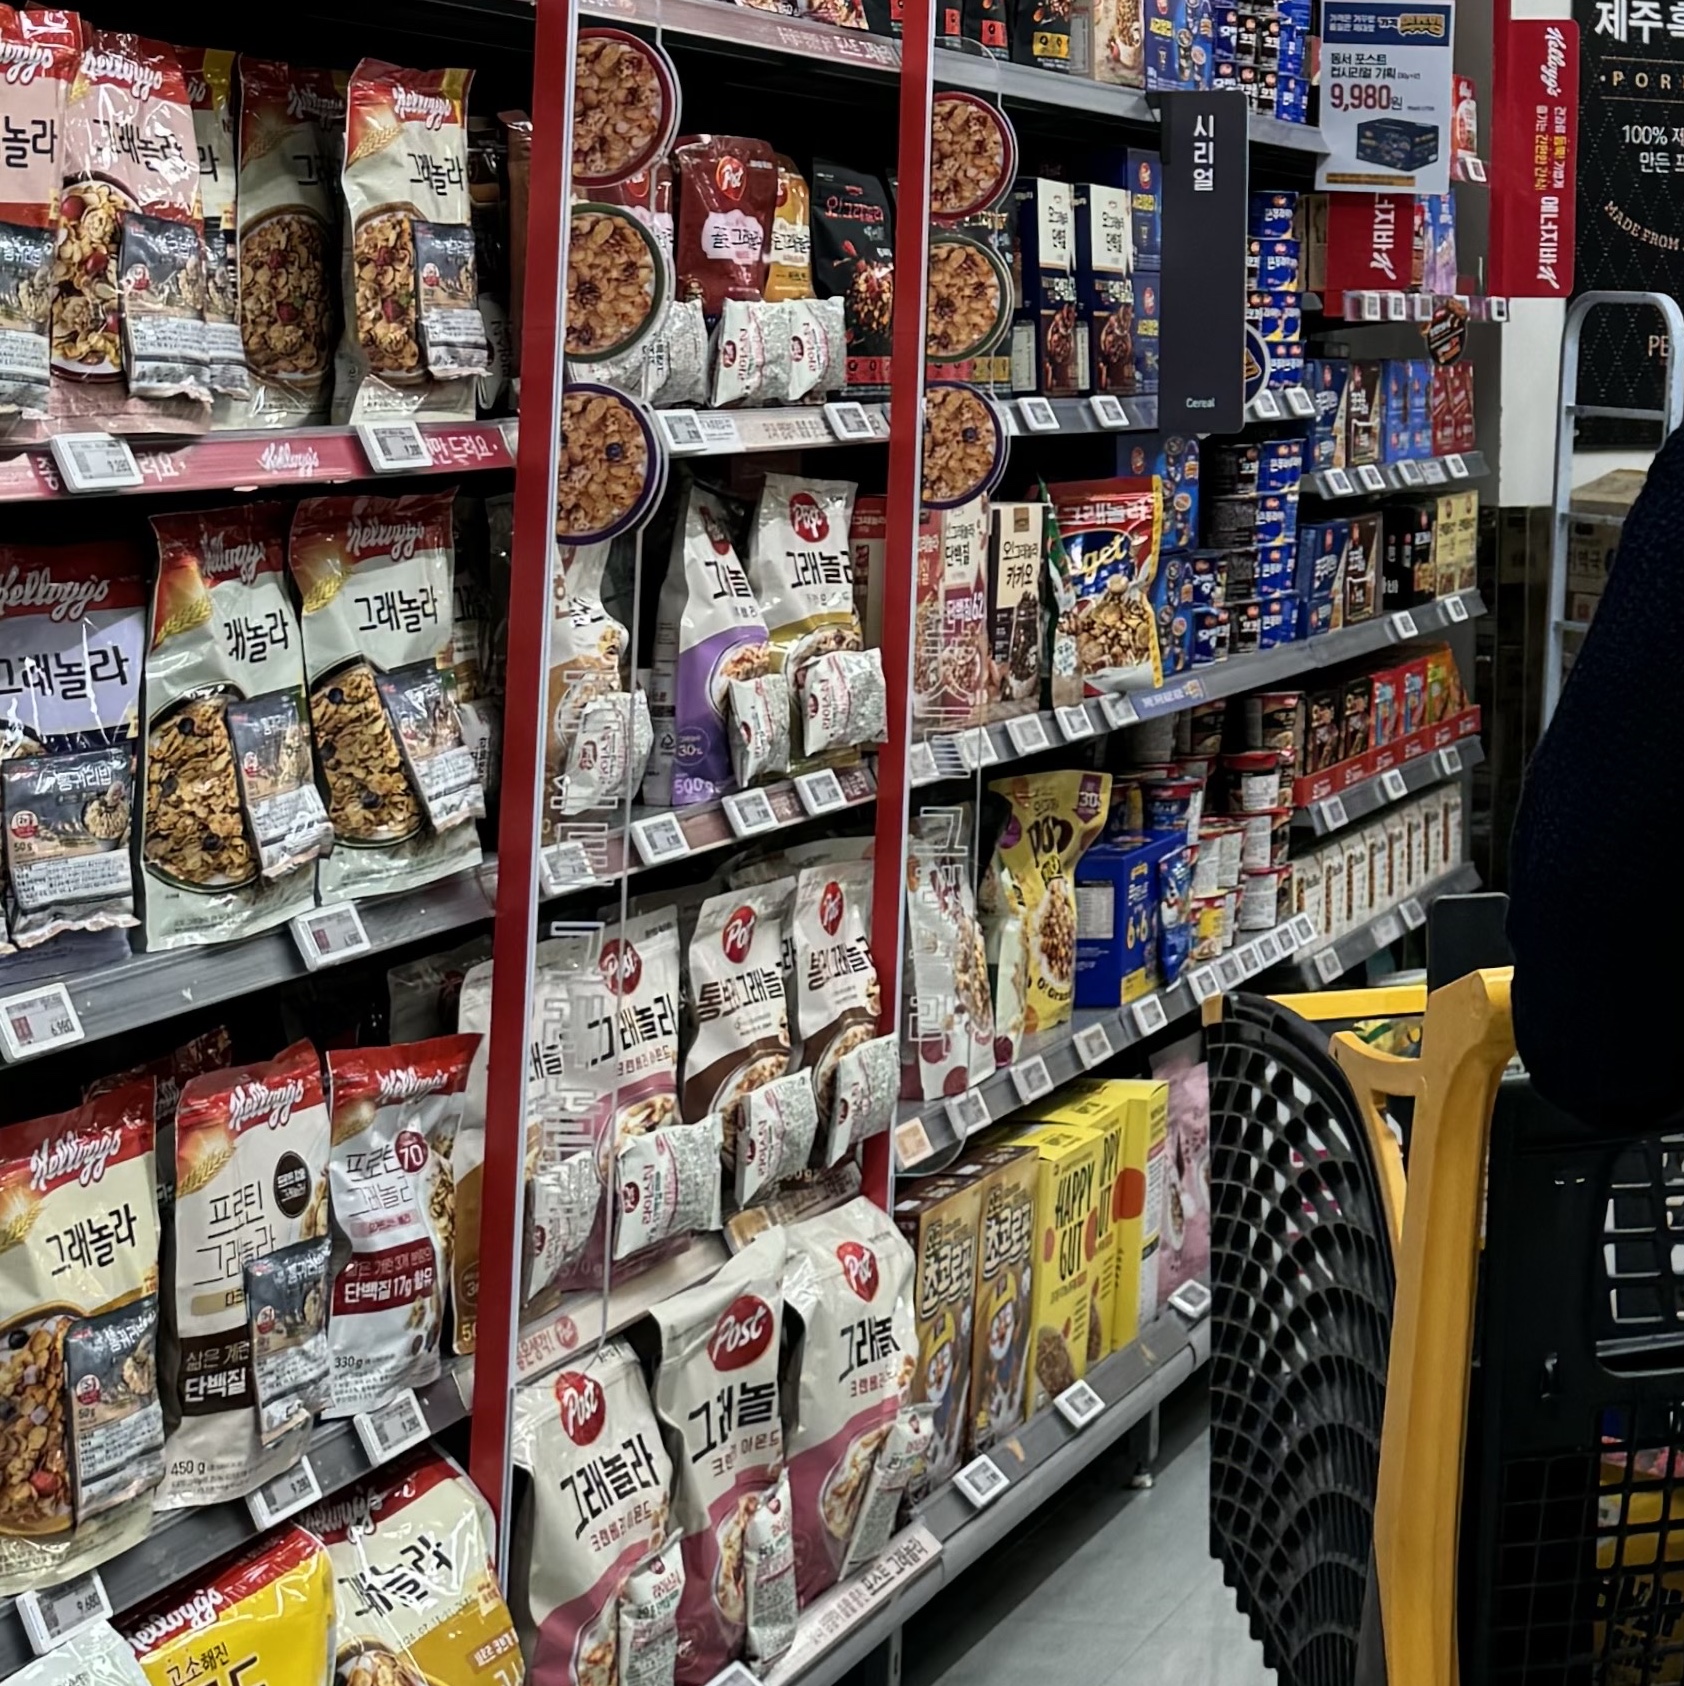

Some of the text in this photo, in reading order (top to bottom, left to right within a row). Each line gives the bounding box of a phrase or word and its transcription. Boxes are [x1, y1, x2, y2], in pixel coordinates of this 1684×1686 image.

[1331, 67, 1372, 79] 컵시리얼
[1375, 67, 1397, 79] 기획
[1355, 53, 1387, 66] 포스트
[1539, 26, 1568, 99] Kellogg's
[2, 116, 57, 168] 놀라
[1193, 114, 1215, 192] 시리얼
[1621, 124, 1668, 146] 100%
[1639, 152, 1671, 174] 만든
[1537, 196, 1560, 263] 에너지바
[1603, 200, 1641, 238] MADE
[1641, 229, 1680, 252] FROM
[1186, 397, 1216, 409] Cereal
[1005, 563, 1034, 589] 카카오
[354, 585, 438, 633] 그래놀라
[228, 1081, 304, 1132] Kellogg's
[30, 1126, 122, 1192] Kellogg's
[399, 1145, 424, 1173] 70
[207, 1180, 265, 1240] 프로틴
[1055, 1160, 1096, 1231] HAPPY
[45, 1203, 137, 1276] 그래놀라
[1058, 1221, 1084, 1282] GUT
[344, 1281, 392, 1304] 단백질
[393, 1276, 412, 1297] 17g
[712, 1304, 767, 1362] Post
[185, 1367, 247, 1403] 단백질
[562, 1378, 599, 1437] Post
[560, 1432, 661, 1540] 그래놀라
